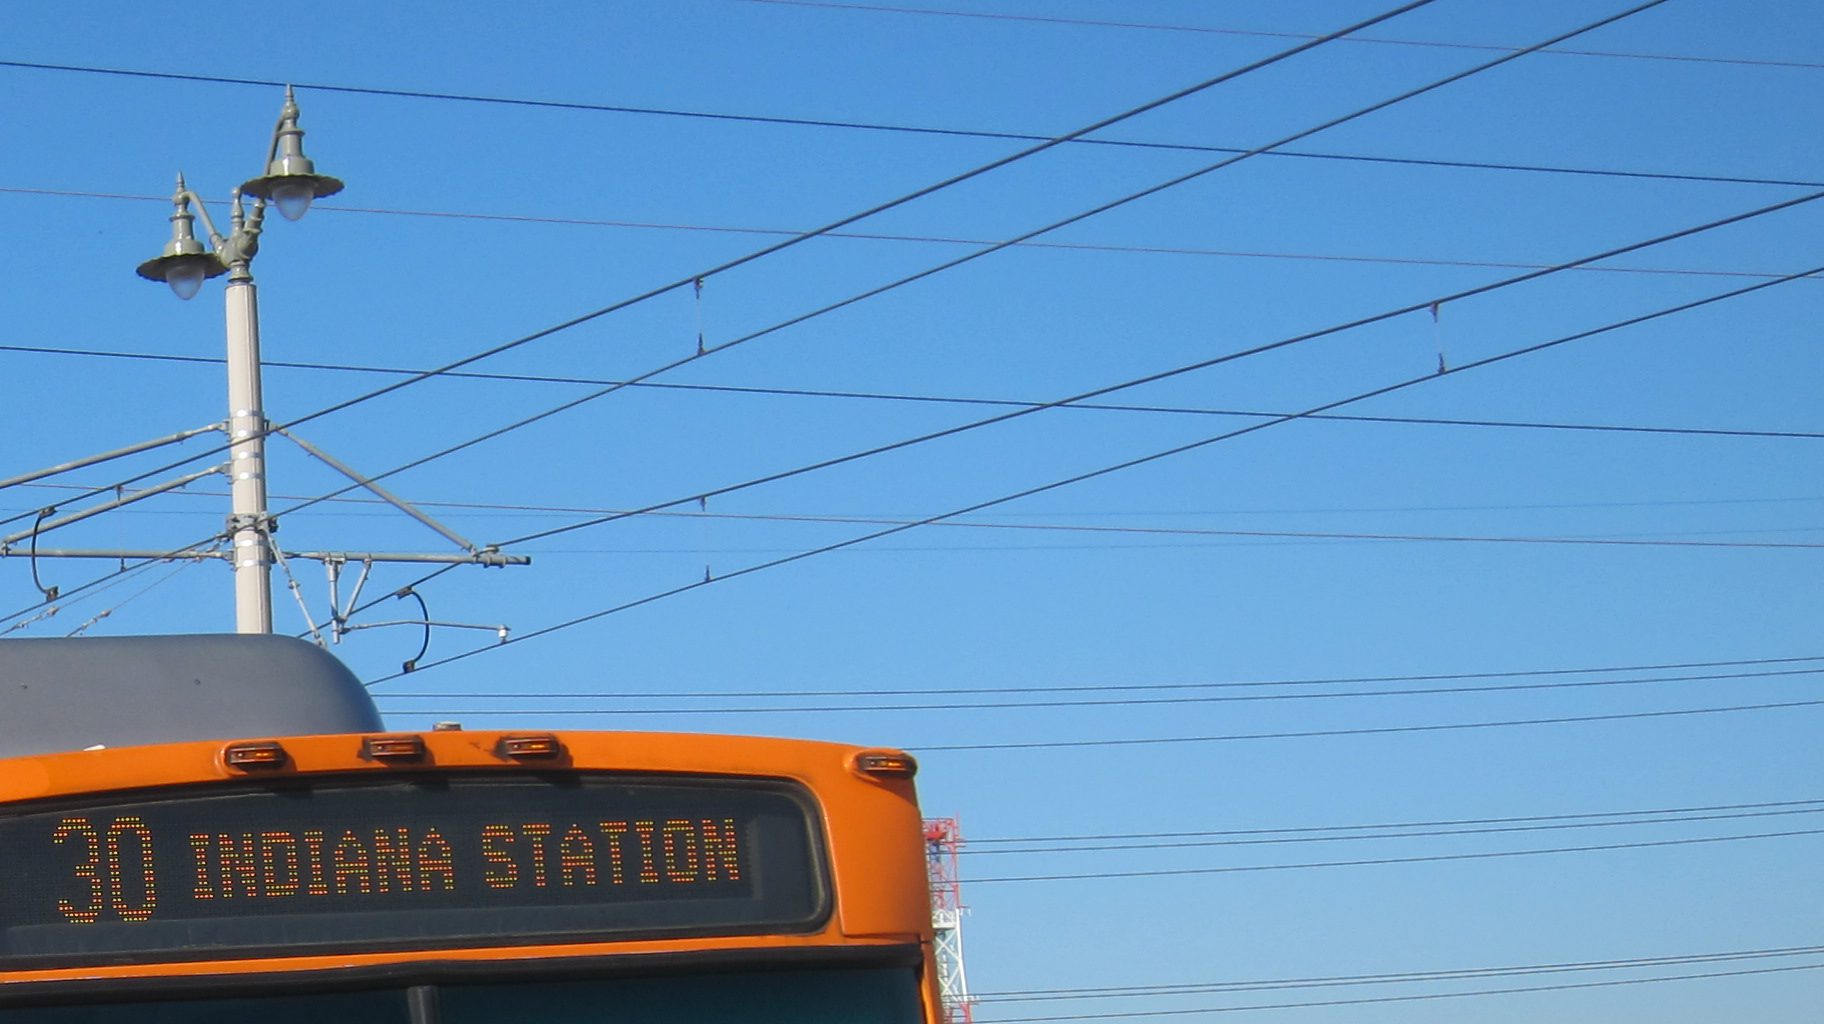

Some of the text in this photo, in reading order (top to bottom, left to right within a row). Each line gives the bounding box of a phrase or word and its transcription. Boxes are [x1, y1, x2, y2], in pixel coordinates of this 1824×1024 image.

[52, 816, 742, 925] 30 INDIANA STATION
